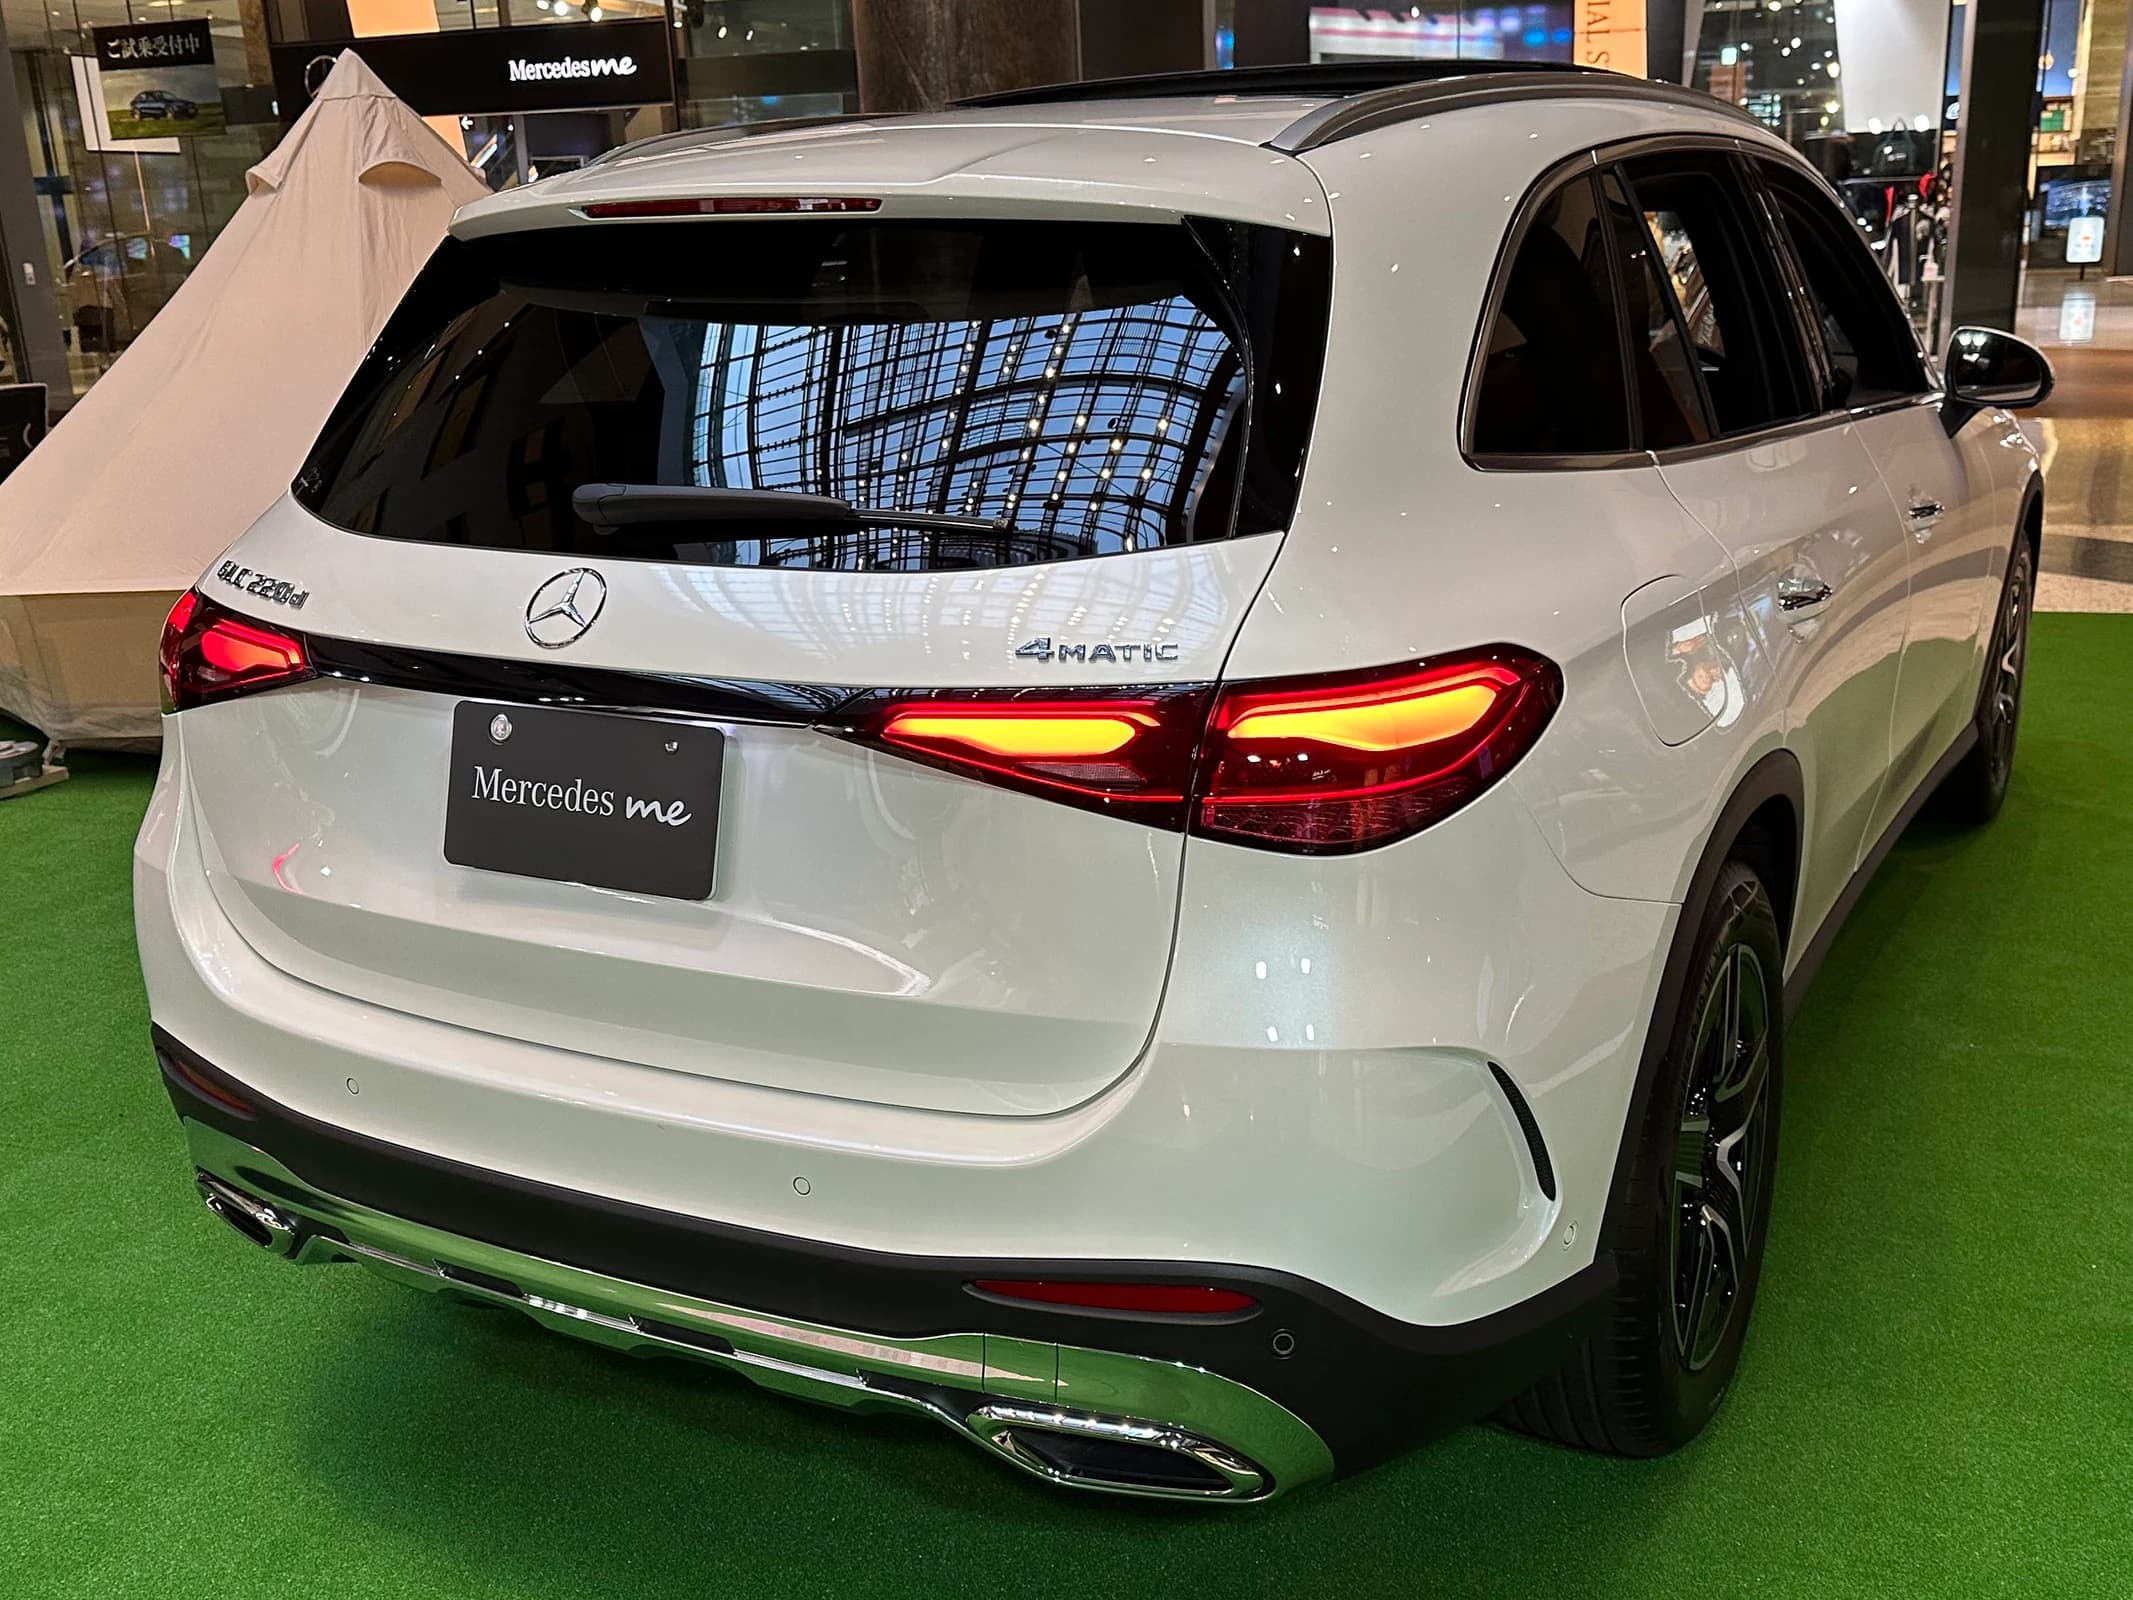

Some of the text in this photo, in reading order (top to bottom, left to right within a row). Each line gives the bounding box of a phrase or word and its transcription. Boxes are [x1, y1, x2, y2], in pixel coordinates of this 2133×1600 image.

[106, 32, 201, 59] ご試乗受付中
[217, 560, 253, 589] GLC
[1014, 637, 1179, 663] 4MATIC
[471, 765, 693, 827] Mercedes me
